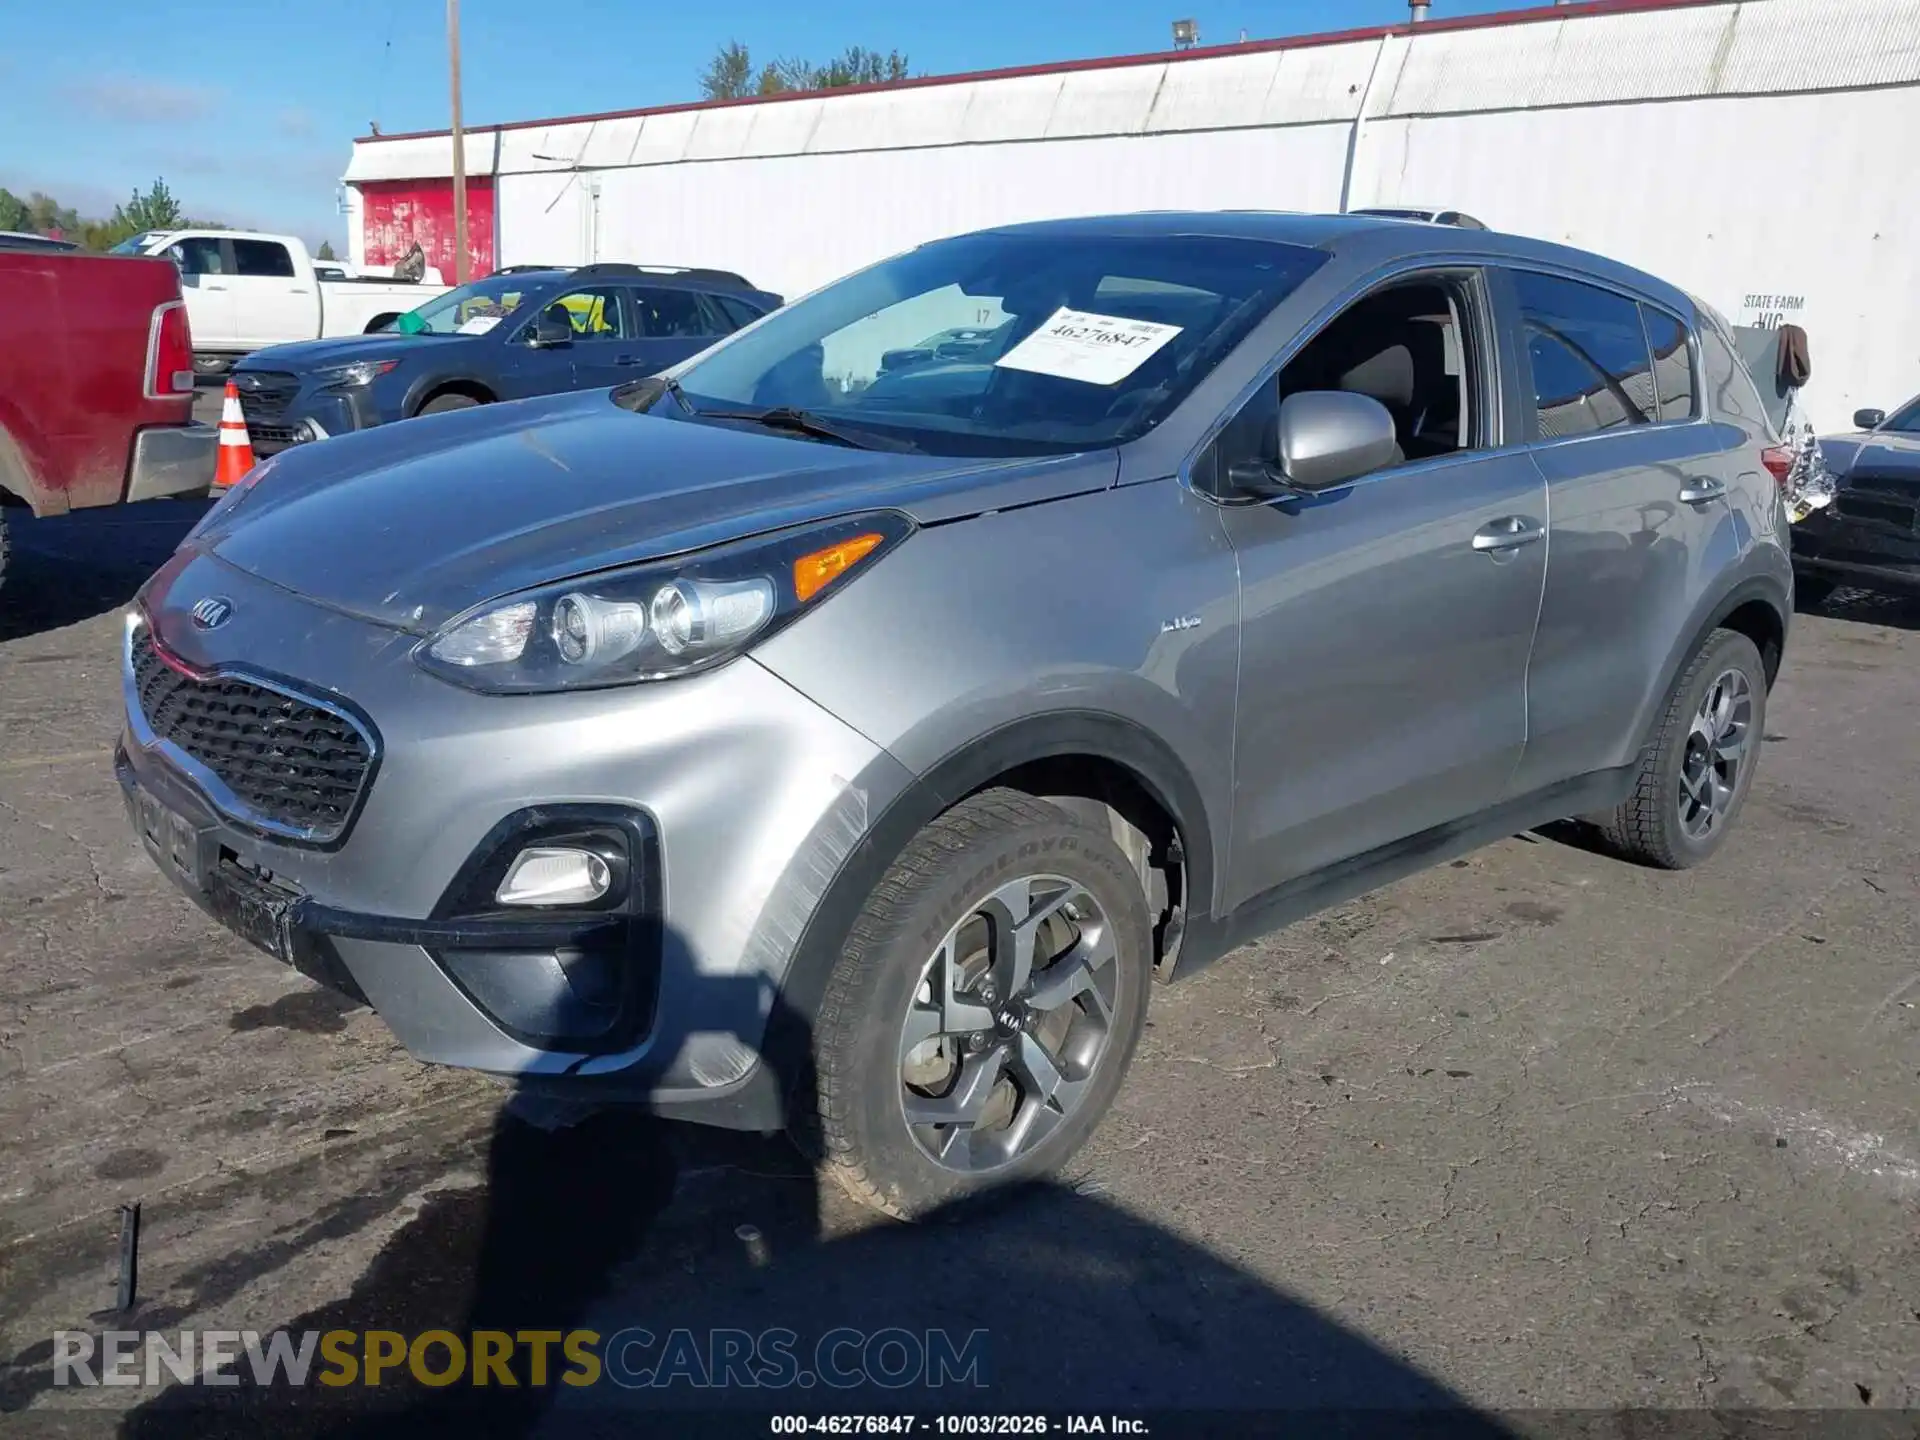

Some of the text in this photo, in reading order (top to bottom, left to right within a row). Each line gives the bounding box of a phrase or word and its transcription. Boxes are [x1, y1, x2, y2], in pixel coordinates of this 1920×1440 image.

[1744, 294, 1805, 310] STATE FARM
[1050, 324, 1153, 348] 46276847
[193, 599, 227, 627] KIA
[1000, 1011, 1020, 1031] KIA
